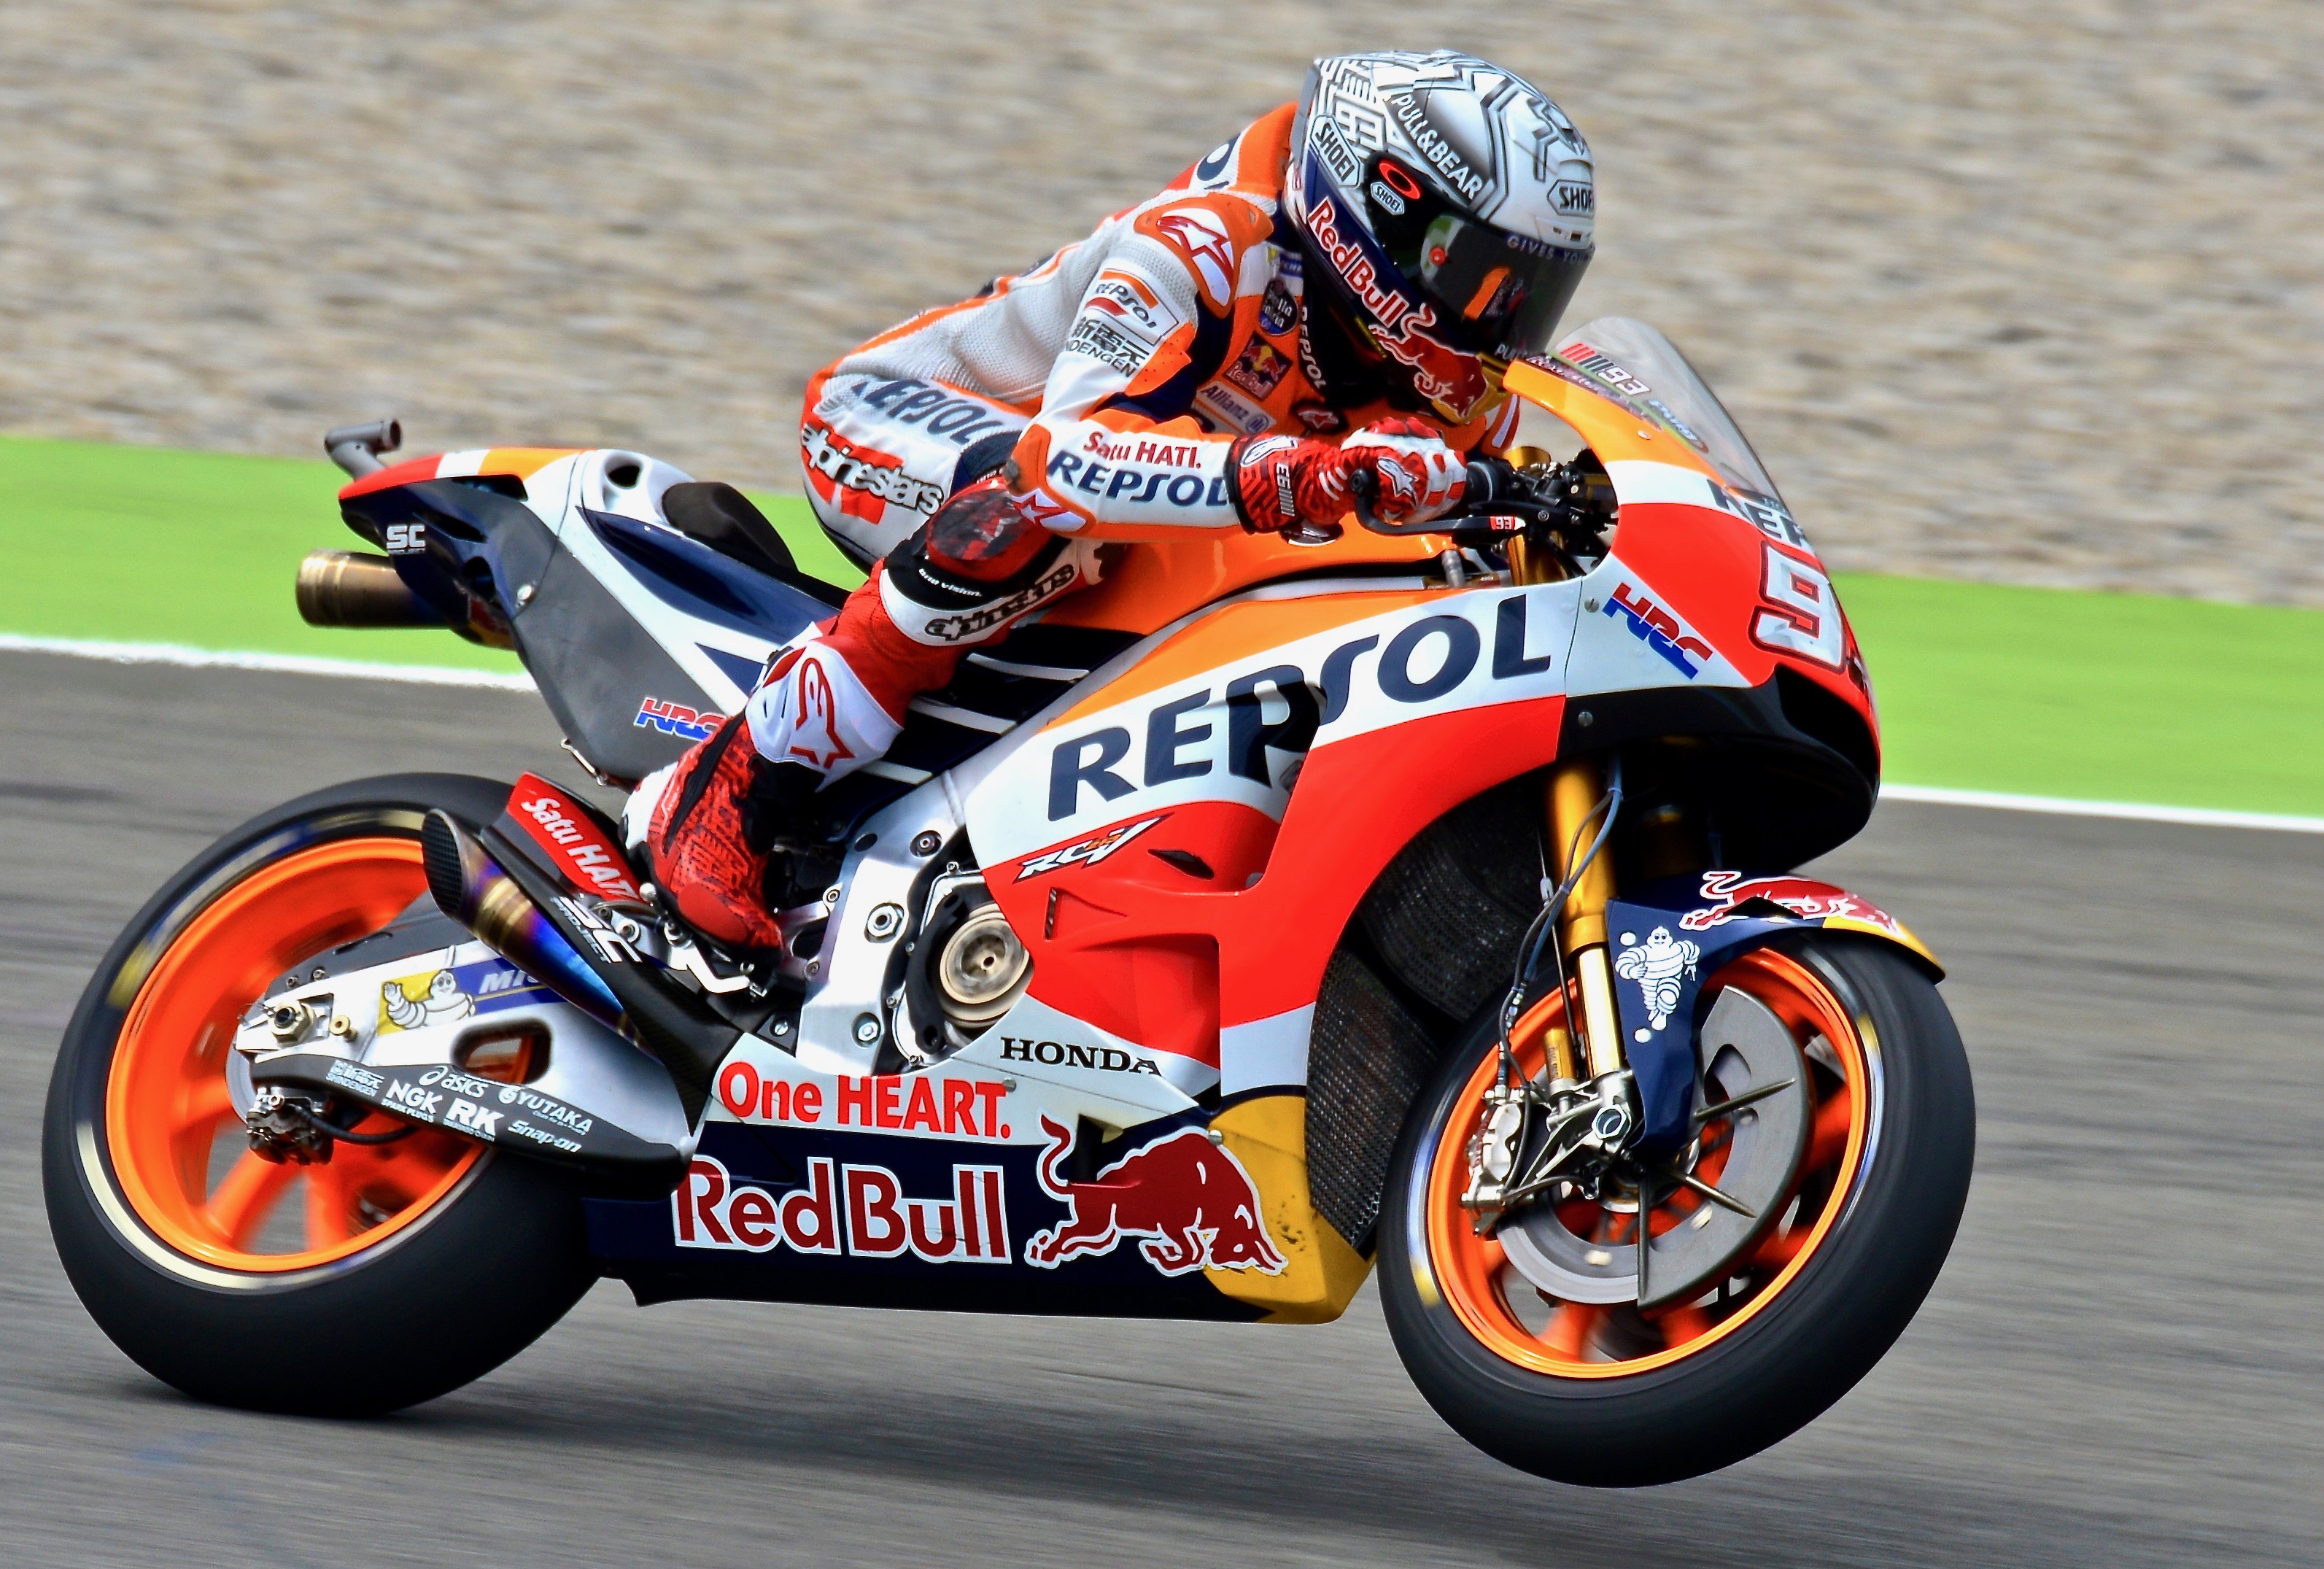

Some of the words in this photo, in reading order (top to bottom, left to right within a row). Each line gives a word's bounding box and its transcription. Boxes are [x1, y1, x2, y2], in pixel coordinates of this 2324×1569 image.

[1315, 122, 1355, 182] SHOEI
[1391, 93, 1483, 201] PULL&BEAR
[1374, 186, 1401, 212] SHOEI
[1558, 185, 1594, 212] SHOE
[1307, 197, 1359, 274] Red
[1344, 260, 1409, 328] Bull
[1506, 236, 1555, 260] GIVES
[1066, 338, 1137, 378] DENGEN
[1597, 366, 1652, 396] 93
[1200, 385, 1250, 420] Allianz
[1083, 431, 1131, 461] Satu
[1134, 441, 1202, 470] HATI.
[1047, 449, 1230, 507] REPSOL
[387, 524, 426, 549] SC
[1495, 516, 1511, 530] 93
[1748, 540, 1848, 675] 9
[1601, 581, 1713, 680] HRC
[633, 697, 728, 743] HRC
[1048, 594, 1552, 822] REPSOL
[521, 797, 584, 845] Satu
[549, 896, 611, 964] PROJECT
[1000, 1036, 1161, 1077] HONDA
[384, 1079, 444, 1115] NGK
[445, 1097, 505, 1136] RK
[517, 1091, 593, 1133] YUTAKA
[718, 1061, 822, 1123] One
[837, 1074, 1012, 1139] HEART.
[508, 1120, 582, 1152] Snap-on
[672, 1154, 842, 1255] Red
[843, 1162, 1012, 1265] Bull
